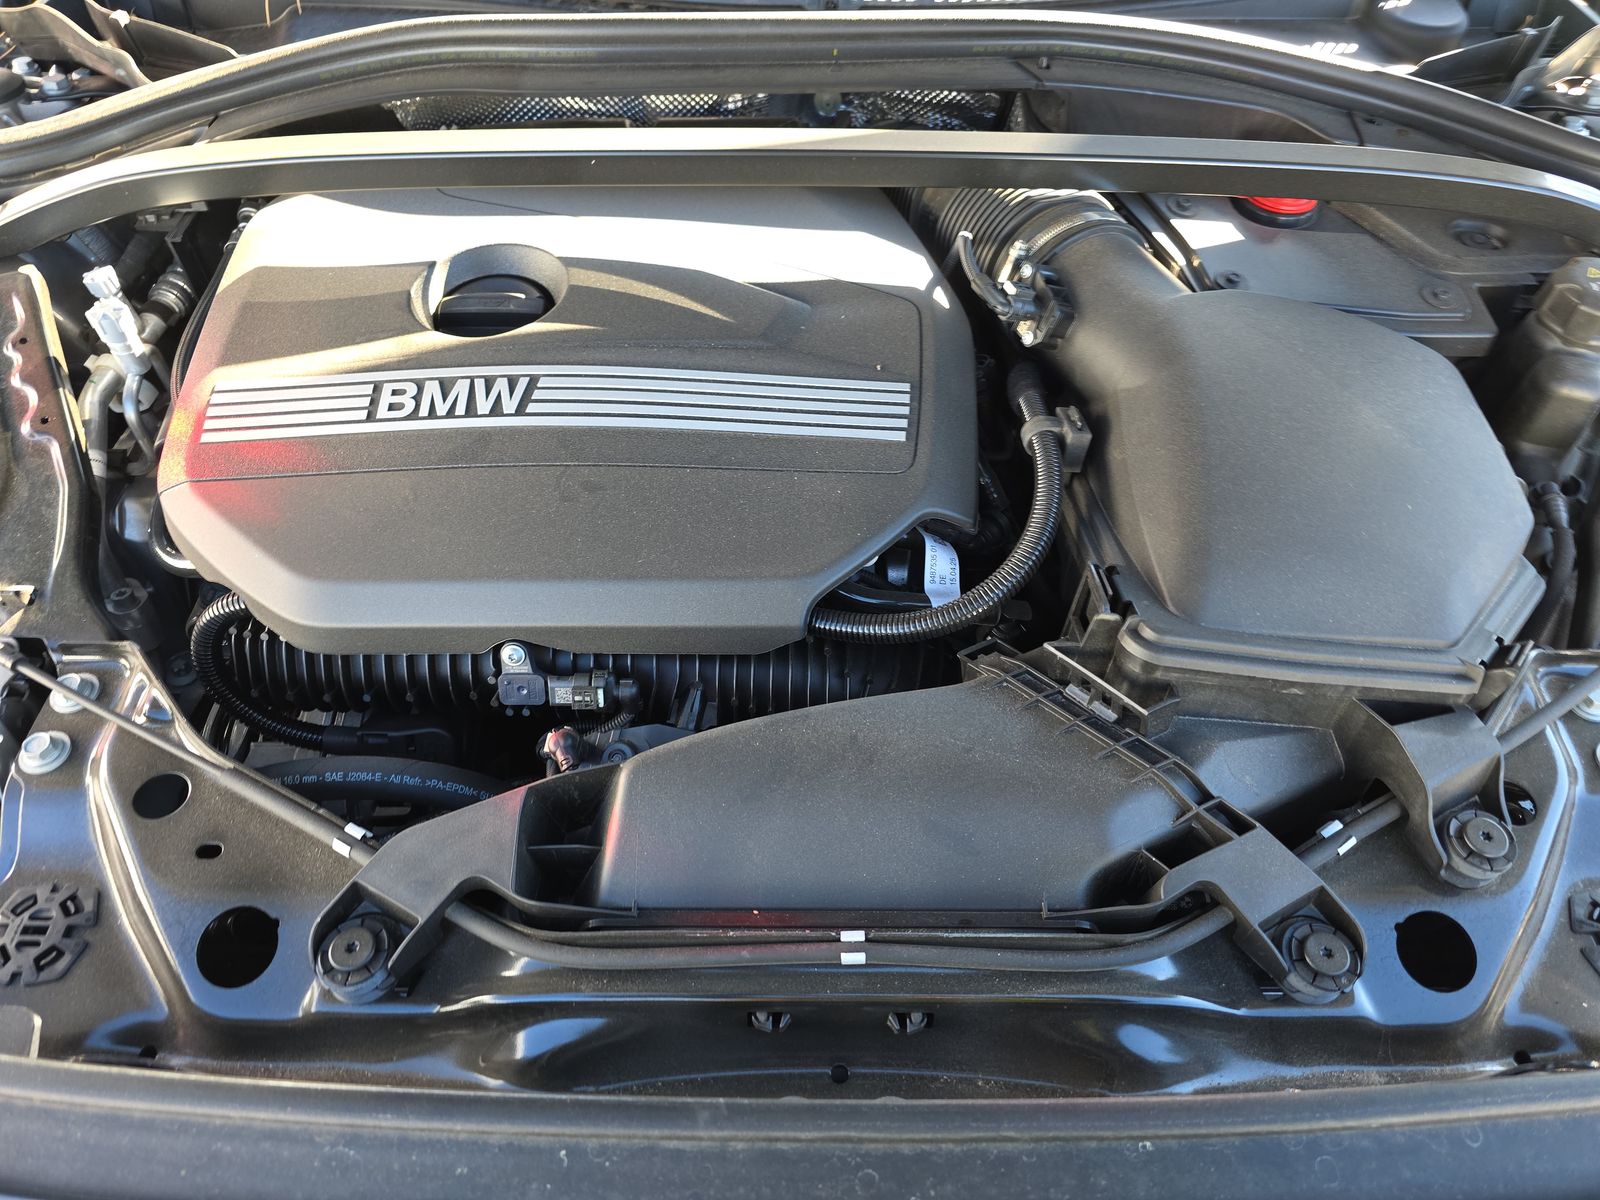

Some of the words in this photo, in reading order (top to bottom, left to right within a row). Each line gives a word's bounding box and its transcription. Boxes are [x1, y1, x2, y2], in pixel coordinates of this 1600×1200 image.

[376, 377, 530, 419] BMW
[939, 575, 947, 585] DE
[302, 774, 318, 784] mm
[324, 772, 344, 782] SAE
[346, 772, 383, 782] J2064-E
[389, 774, 402, 783] All
[402, 775, 423, 786] Refr.
